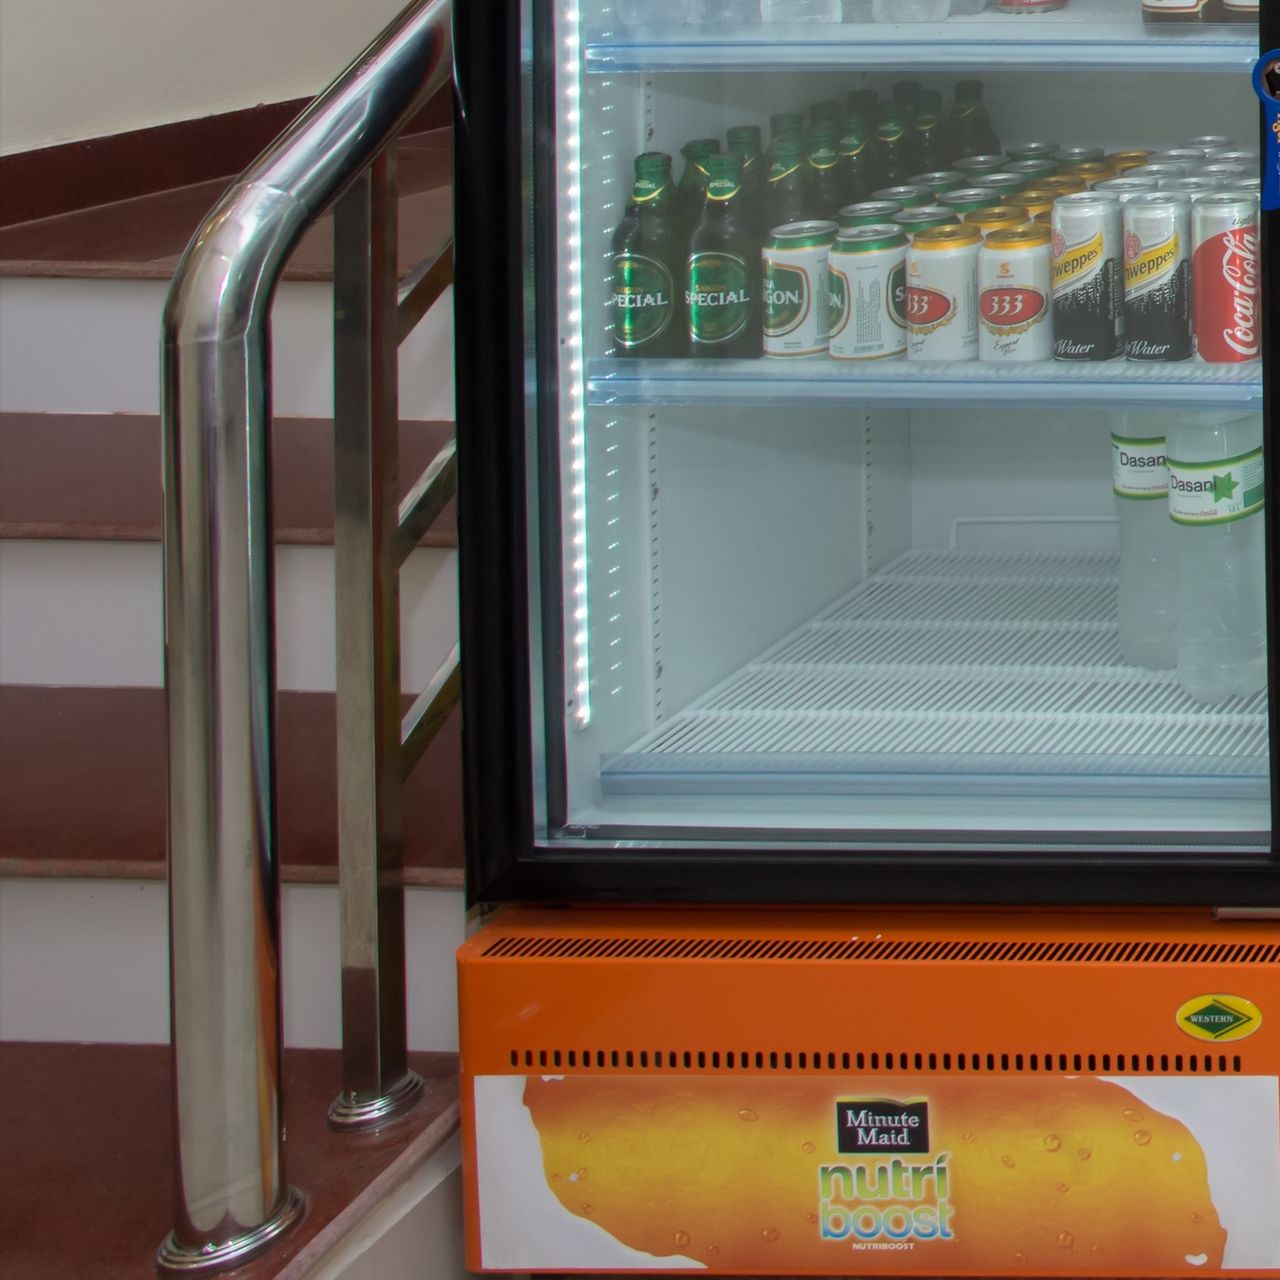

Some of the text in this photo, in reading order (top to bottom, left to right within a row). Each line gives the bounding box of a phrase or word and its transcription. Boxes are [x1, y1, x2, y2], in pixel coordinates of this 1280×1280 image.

[684, 290, 750, 306] SPECIAL
[1223, 231, 1258, 356] Coca-Cola
[988, 294, 1023, 316] 333
[1056, 340, 1095, 355] Water
[1128, 340, 1171, 355] Water
[1119, 452, 1166, 468] Dasan
[1190, 1014, 1234, 1023] WESTERN
[846, 1110, 920, 1128] Minute
[857, 1128, 911, 1145] Maid
[819, 1199, 954, 1239] boost
[852, 1242, 915, 1251] NUTRIBOOST
